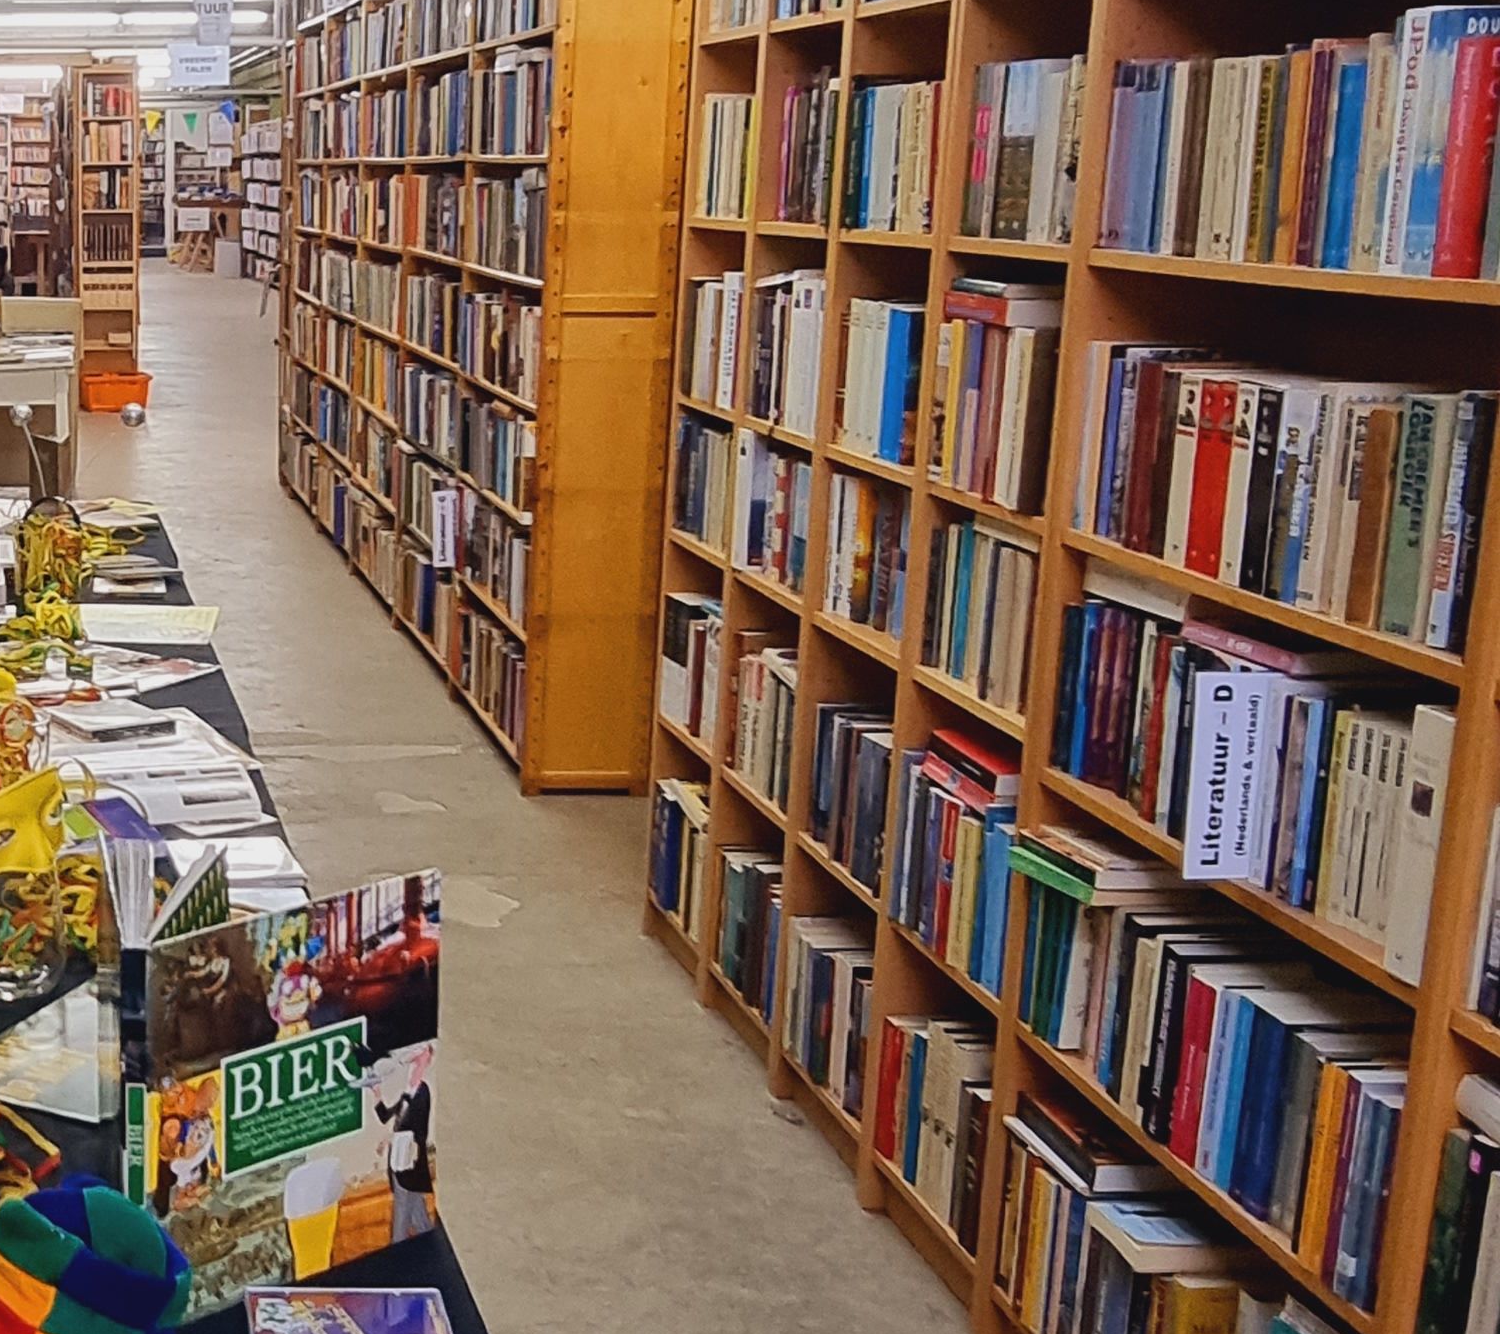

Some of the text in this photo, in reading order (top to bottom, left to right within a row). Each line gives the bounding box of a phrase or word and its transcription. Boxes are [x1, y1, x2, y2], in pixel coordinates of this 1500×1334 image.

[1213, 683, 1234, 703] D
[1200, 727, 1228, 867] Literatuur
[1234, 694, 1264, 857] (Nederlands & vertaald)
[229, 1035, 362, 1120] BIER
